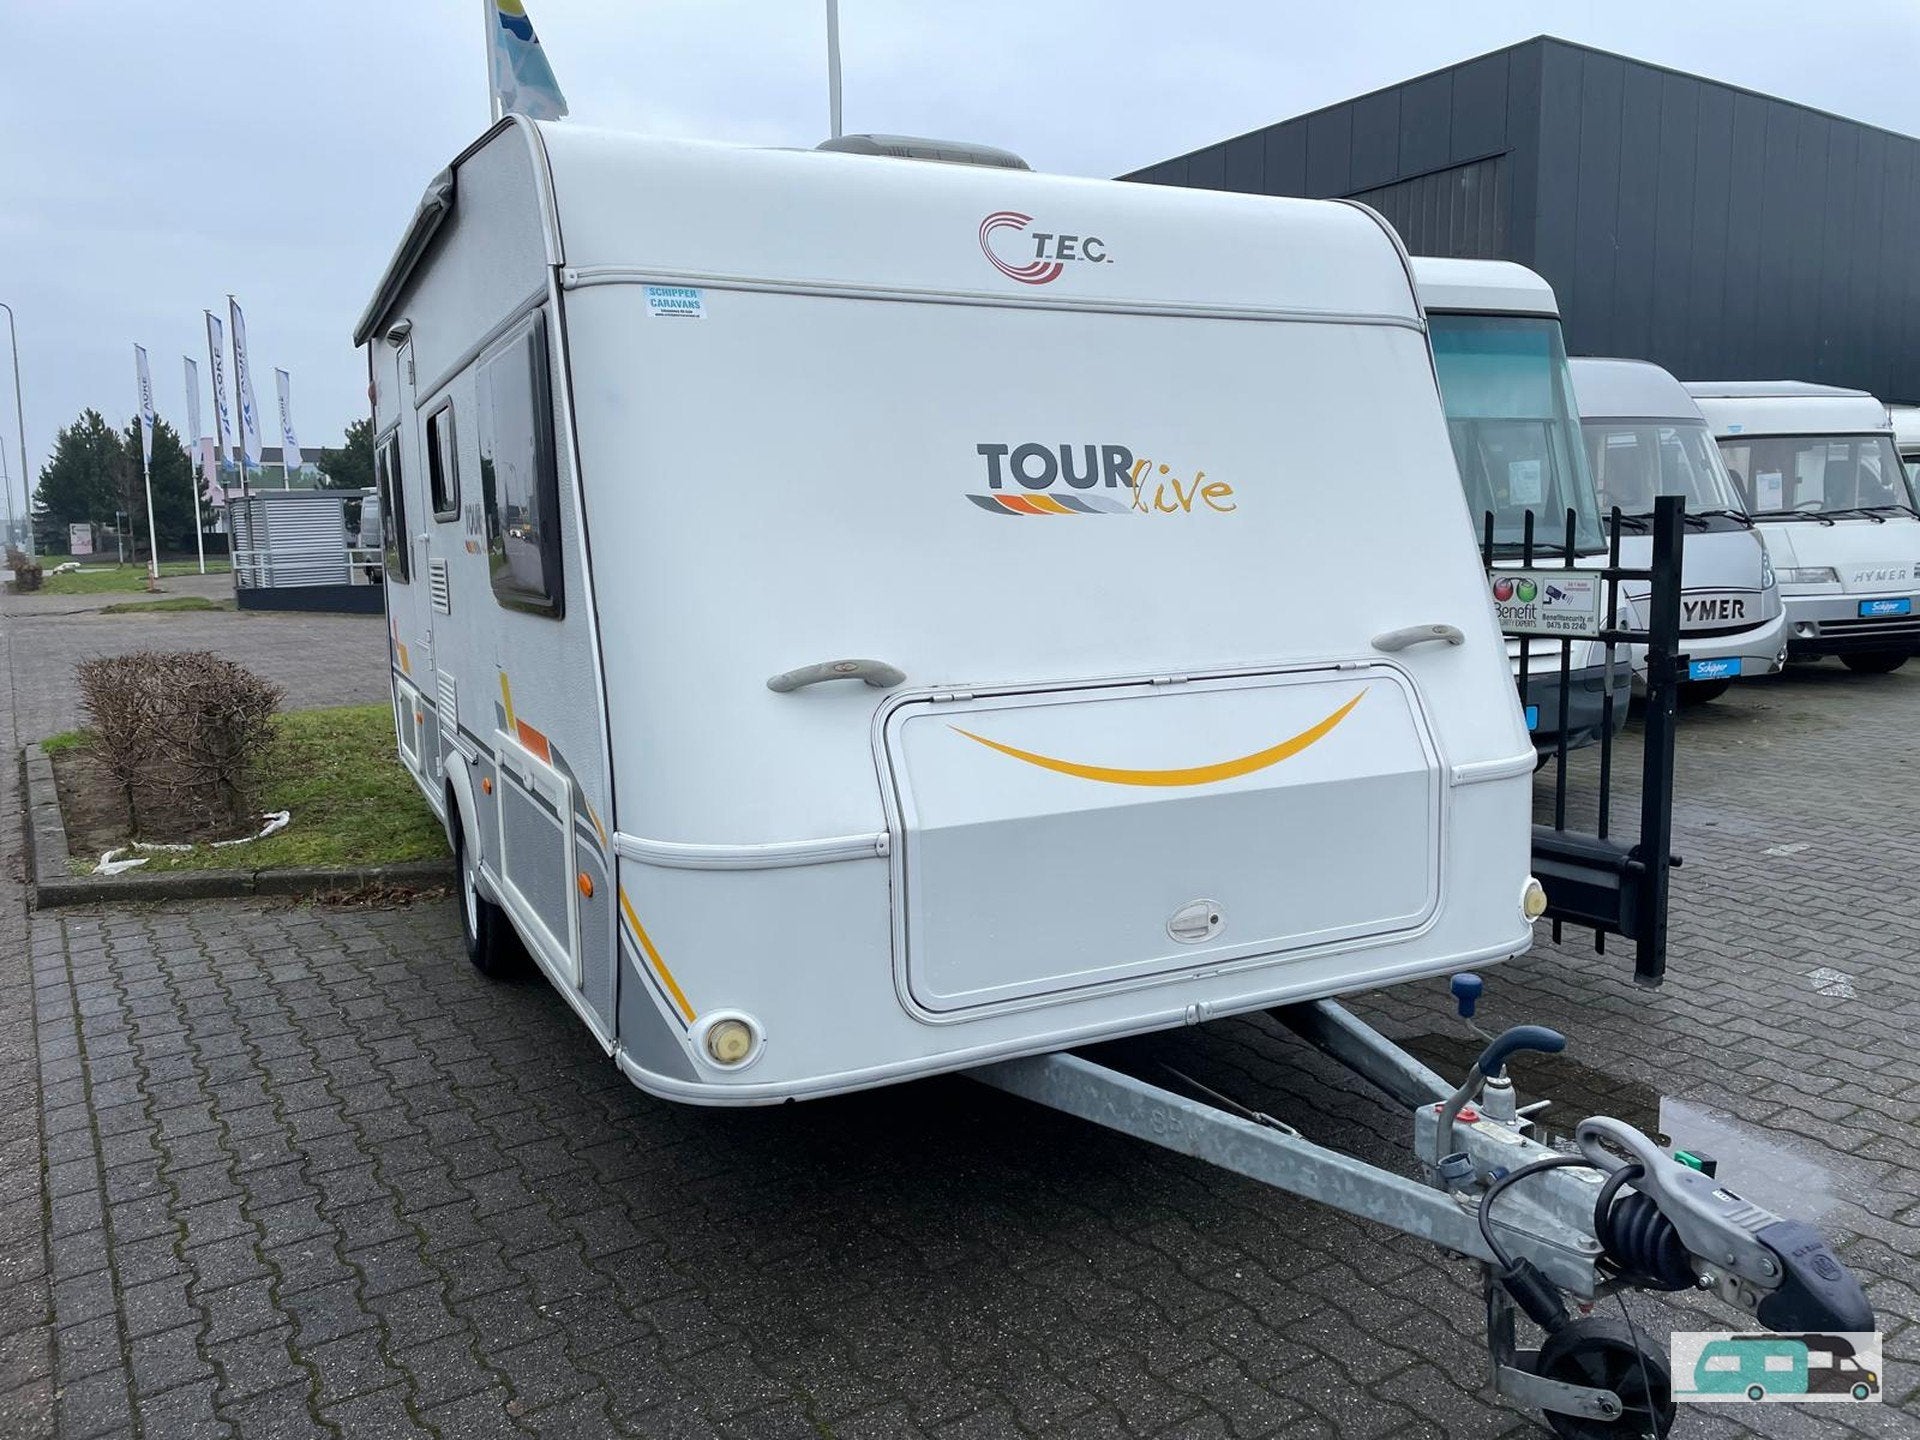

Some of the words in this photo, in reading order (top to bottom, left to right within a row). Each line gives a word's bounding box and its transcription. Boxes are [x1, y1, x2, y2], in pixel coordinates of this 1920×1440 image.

[649, 287, 697, 298] SCHIPPER
[650, 299, 701, 309] CARAVANS
[976, 443, 1139, 490] TOUR
[1132, 459, 1237, 513] live
[1854, 569, 1907, 582] HYMER
[1683, 599, 1745, 621] YMER
